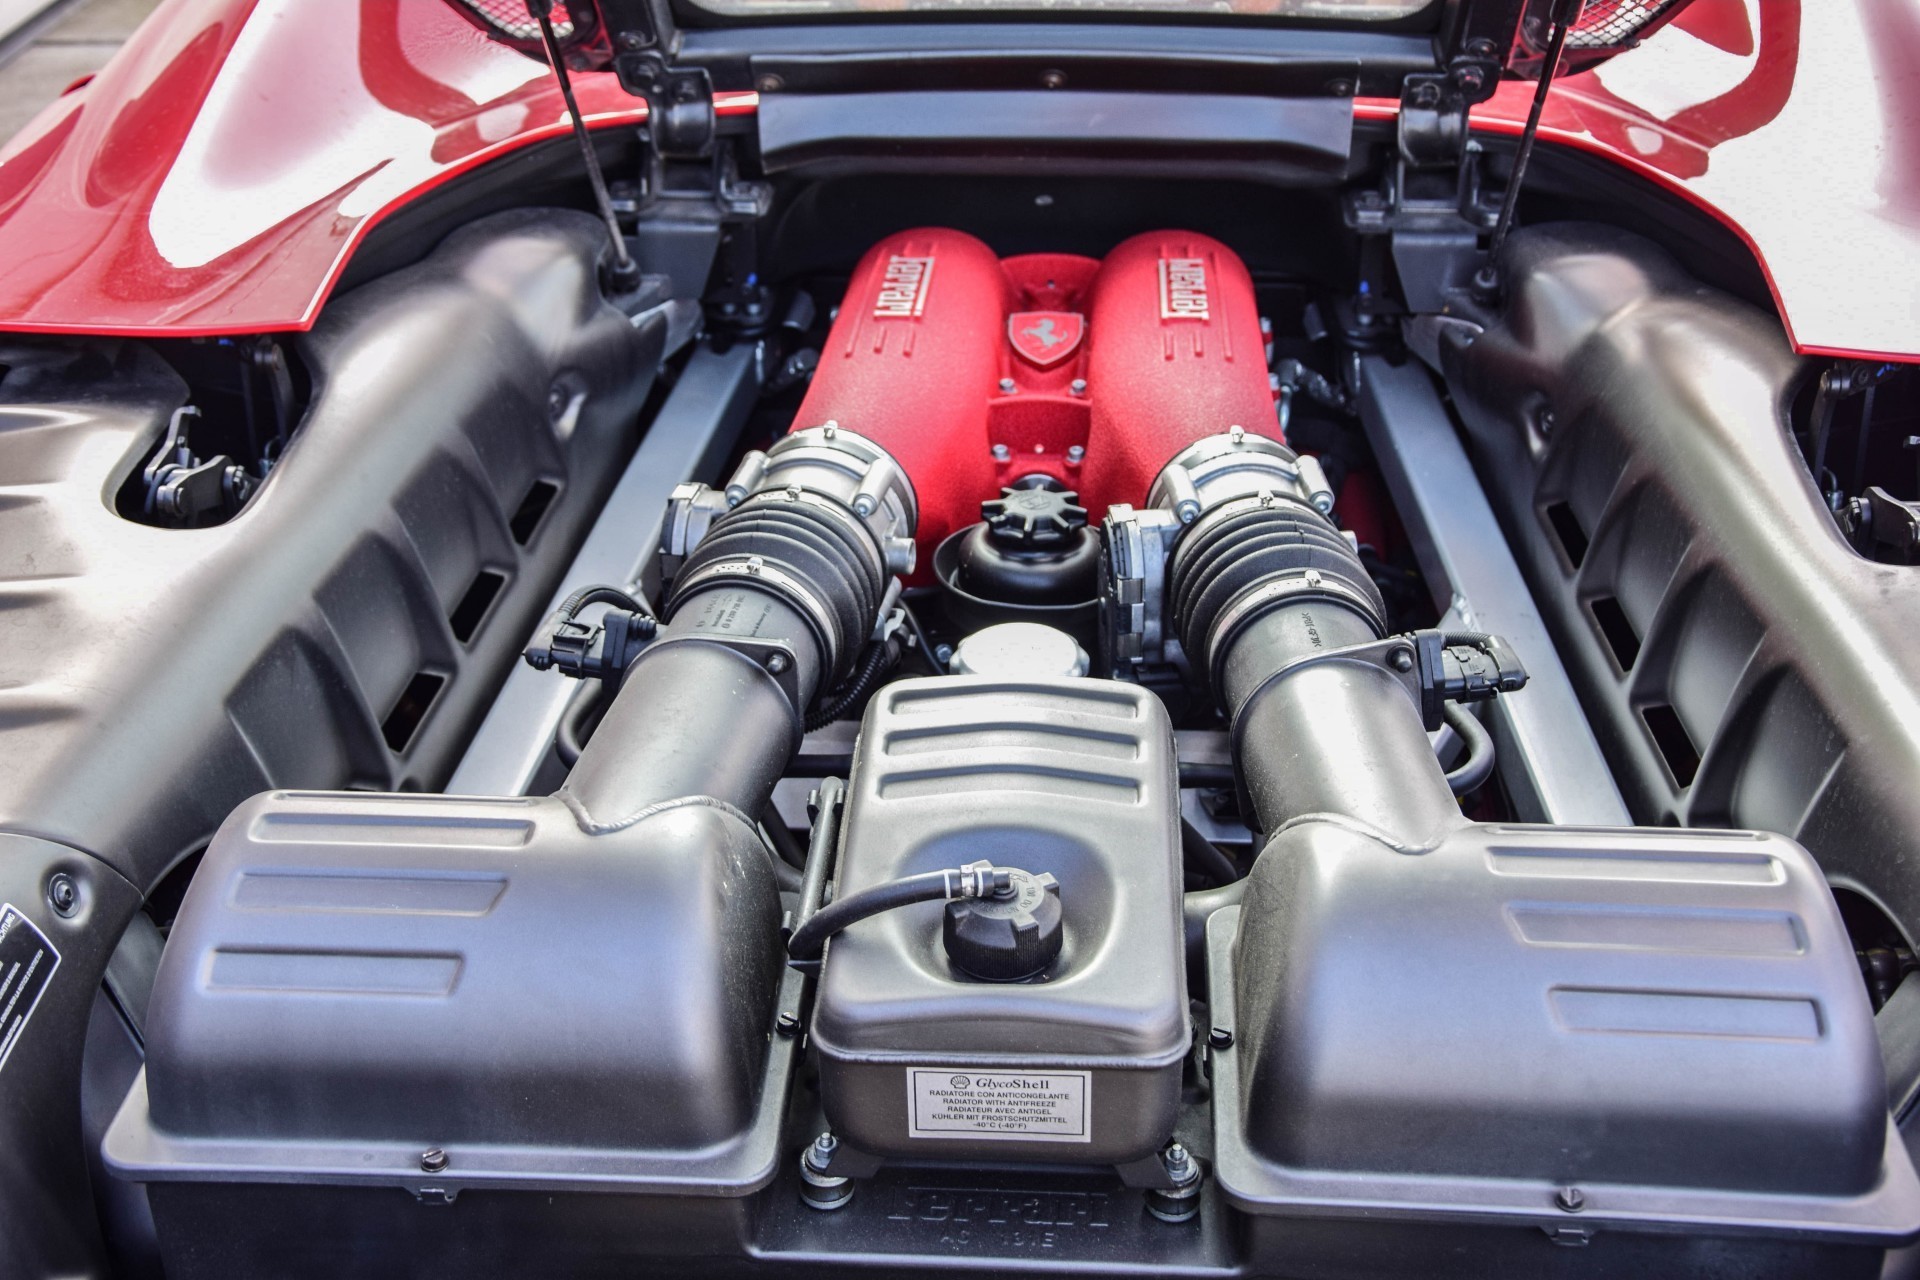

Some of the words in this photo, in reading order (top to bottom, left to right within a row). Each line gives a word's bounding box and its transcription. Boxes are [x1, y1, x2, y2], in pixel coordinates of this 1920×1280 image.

[976, 1077, 1049, 1089] GlycoShell
[997, 1092, 1070, 1100] ANTICONGELANTE
[982, 1115, 1067, 1123] FROSTSCHUTZMITTEL
